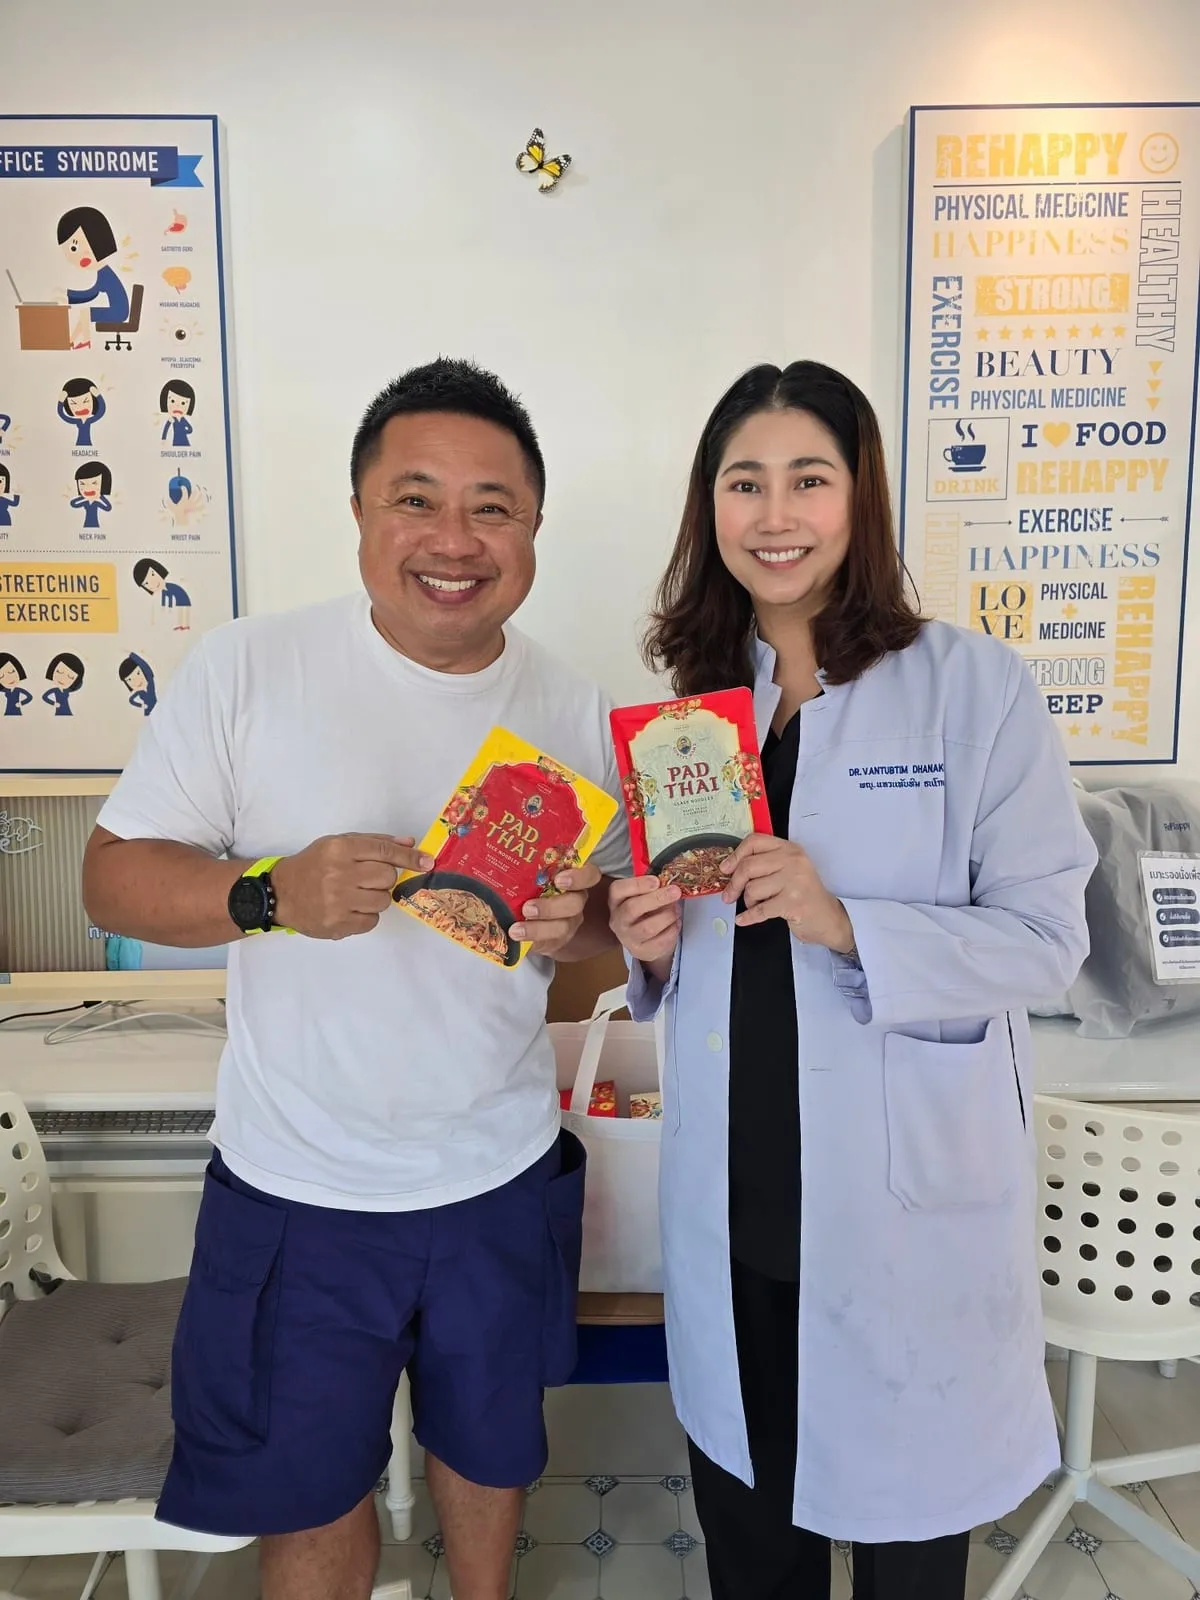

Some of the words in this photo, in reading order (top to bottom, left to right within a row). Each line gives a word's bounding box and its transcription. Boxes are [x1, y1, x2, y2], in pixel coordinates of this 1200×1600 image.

[0, 151, 45, 172] FICE
[57, 151, 159, 172] SYNDROME
[935, 132, 1128, 178] REHAPPY
[934, 193, 1029, 221] PHYSICAL
[1035, 191, 1129, 218] MEDICINE
[931, 228, 1129, 259] HAPPINESS
[1135, 189, 1182, 352] HEALTHY
[994, 275, 1111, 312] STRONG
[929, 275, 963, 411] EXERCISE
[974, 348, 1120, 378] BEAUTY
[970, 389, 1046, 411] PHYSICAL
[1050, 387, 1127, 408] MEDICINE
[1021, 424, 1039, 447] I
[1075, 421, 1167, 446] FOOD
[933, 477, 1000, 494] DRINK
[1016, 458, 1170, 495] REHAPPY
[1018, 507, 1113, 533] EXERCISE
[967, 543, 1161, 572] HAPPINESS
[1041, 582, 1108, 601] PHYSICAL
[6, 603, 90, 622] EXERCISE
[1039, 621, 1106, 640] MEDICINE
[1111, 575, 1156, 746] REHAPPY
[667, 761, 709, 782] PAD
[663, 776, 720, 799] THAI
[500, 810, 539, 843] PAD
[487, 821, 538, 863] THAI
